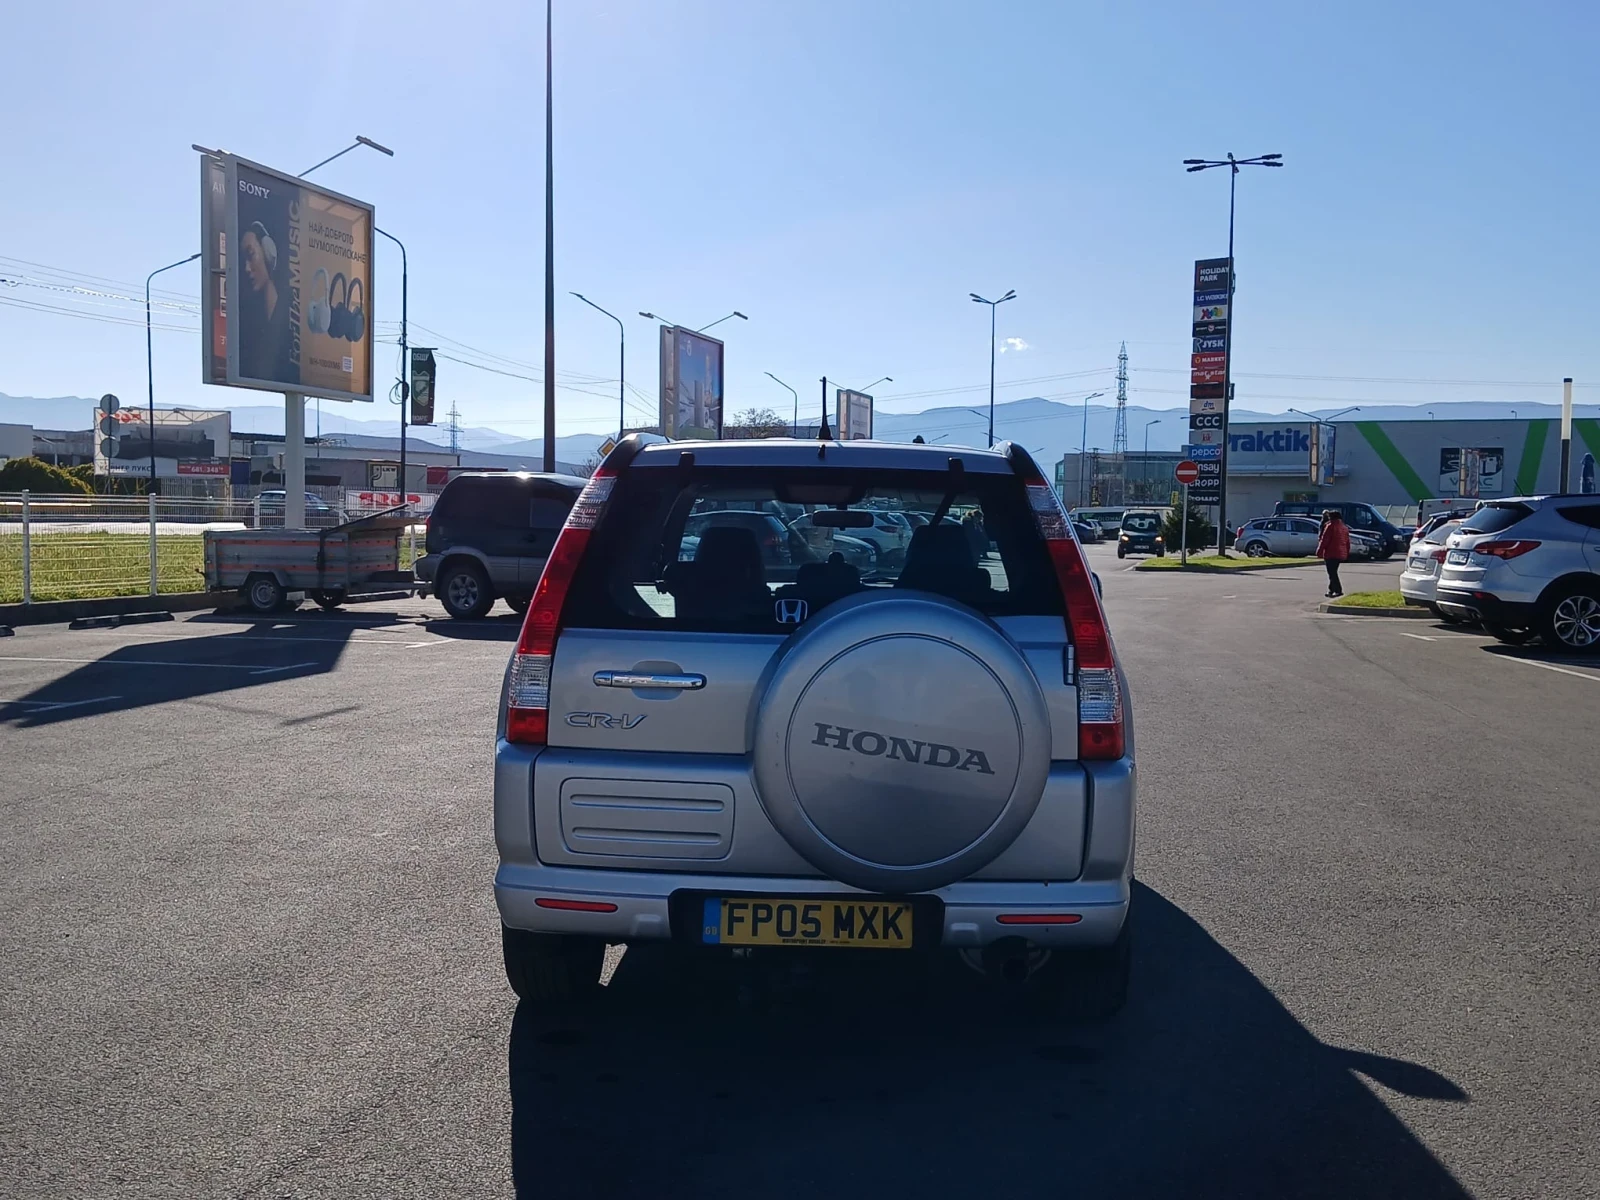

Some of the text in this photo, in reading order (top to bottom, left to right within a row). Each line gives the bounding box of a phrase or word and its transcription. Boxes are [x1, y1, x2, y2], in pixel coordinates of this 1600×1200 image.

[239, 180, 270, 199] SONY
[308, 221, 354, 245] НАЙ-ДОБРОТО
[308, 237, 367, 264] ШУМОПОТИСКАНЕ
[1200, 267, 1229, 275] HOLIDAY
[1202, 339, 1224, 348] JYSK
[1196, 416, 1220, 427] CCC
[1228, 428, 1309, 452] raktik
[1191, 448, 1220, 457] pepco
[564, 711, 648, 731] CR-V
[812, 721, 996, 776] HONDA
[727, 902, 904, 940] FP05 MXK
